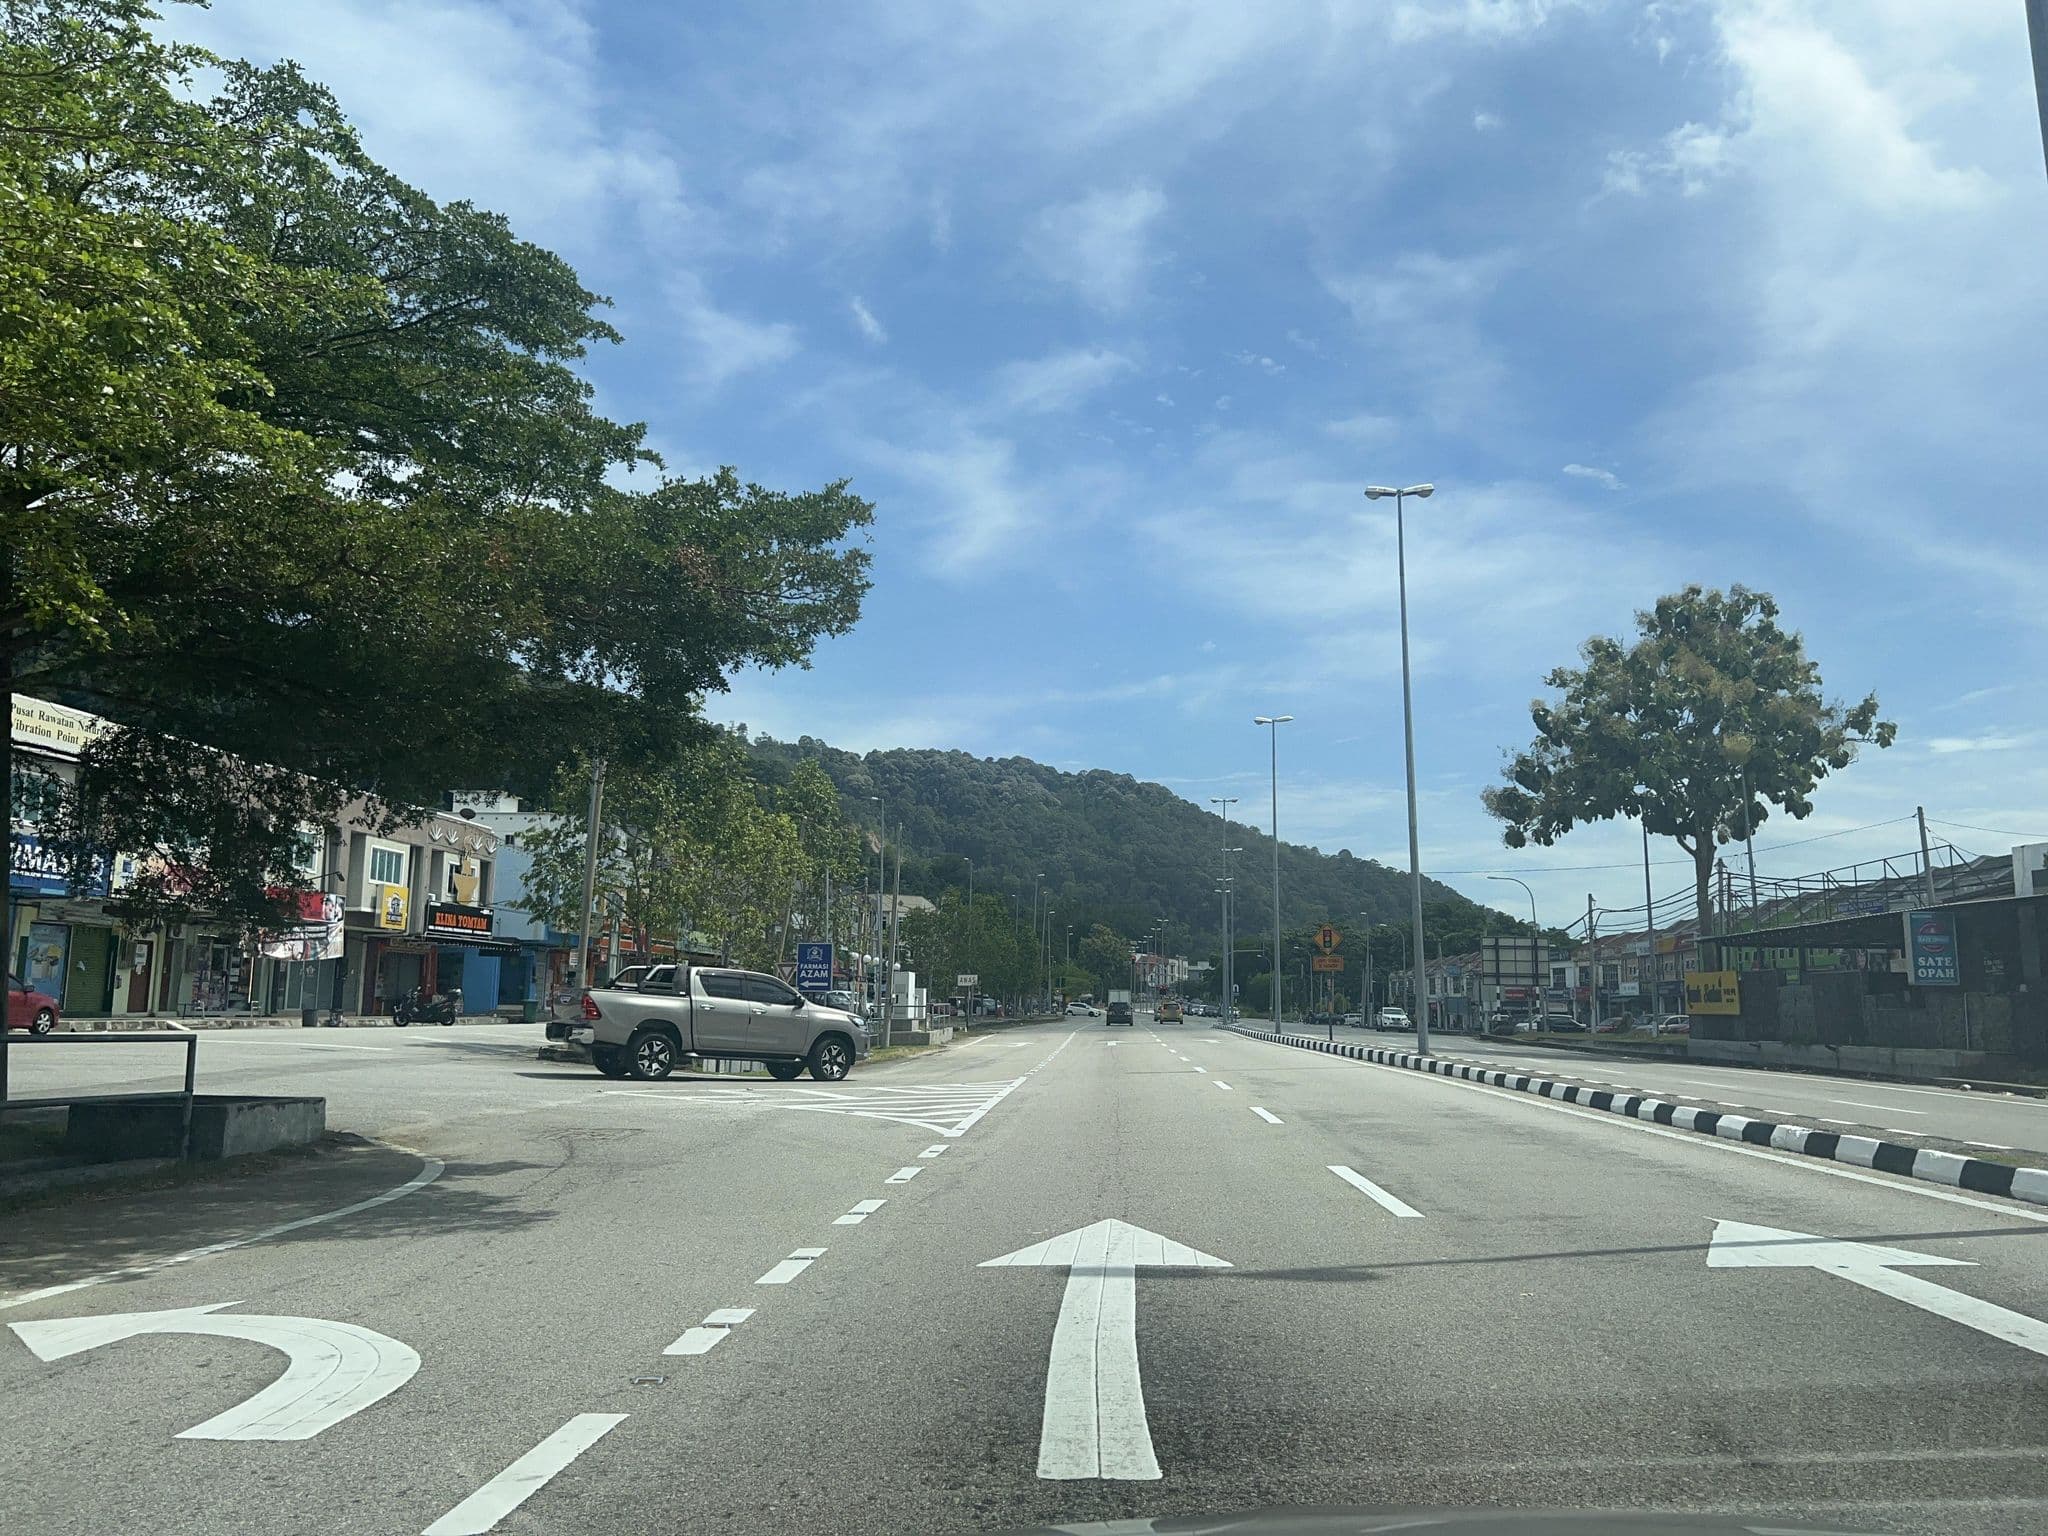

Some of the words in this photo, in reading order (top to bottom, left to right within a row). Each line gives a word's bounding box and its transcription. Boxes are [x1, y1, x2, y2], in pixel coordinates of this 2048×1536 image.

[11, 703, 34, 718] Pusat
[39, 710, 74, 729] Rawatan
[14, 718, 52, 738] ibration
[57, 730, 79, 745] Point
[1918, 956, 1953, 967] SATE
[799, 970, 829, 978] AZAM
[1918, 968, 1956, 978] OPAH
